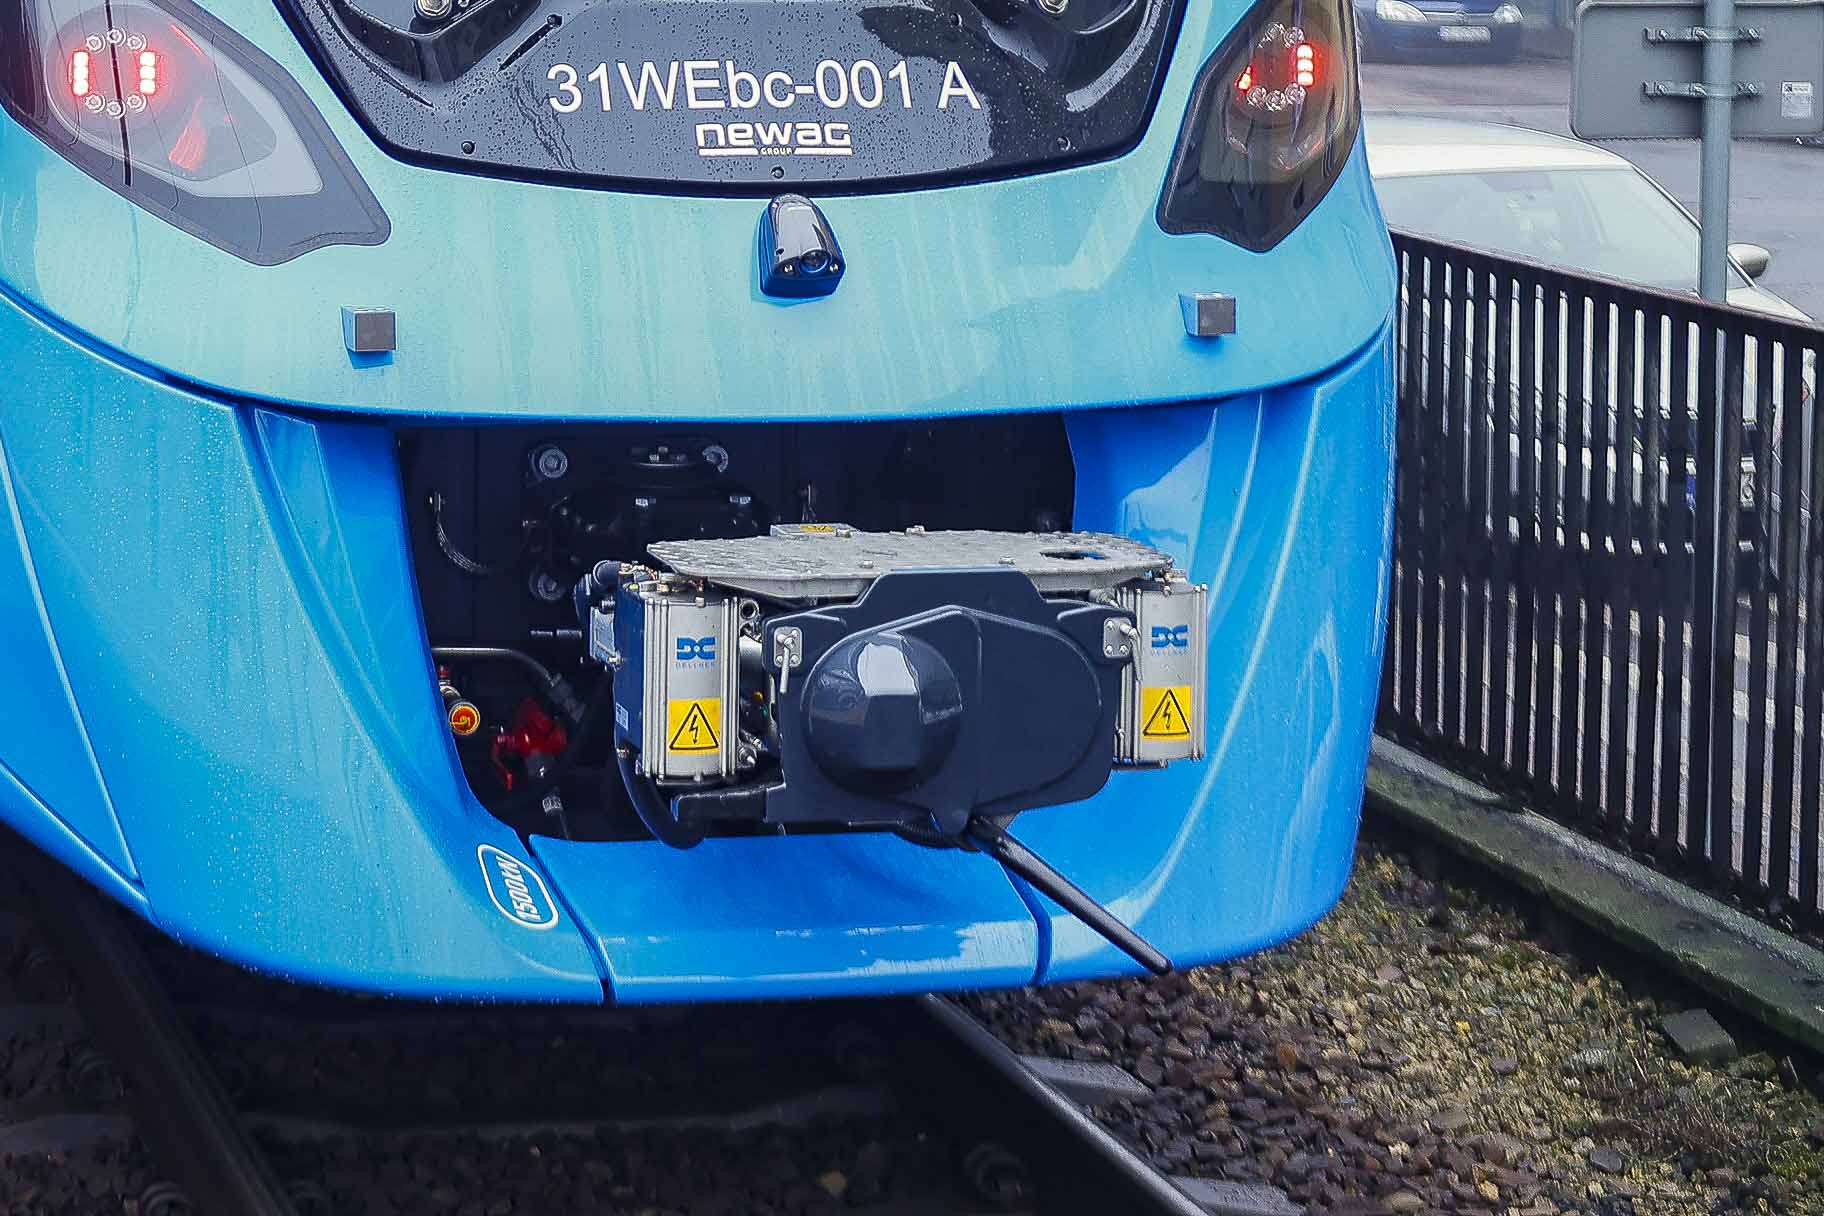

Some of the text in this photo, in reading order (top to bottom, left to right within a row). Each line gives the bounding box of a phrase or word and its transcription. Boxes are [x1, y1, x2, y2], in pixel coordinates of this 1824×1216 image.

[546, 59, 984, 114] 31WEbc-001 A
[760, 146, 792, 156] GROUP
